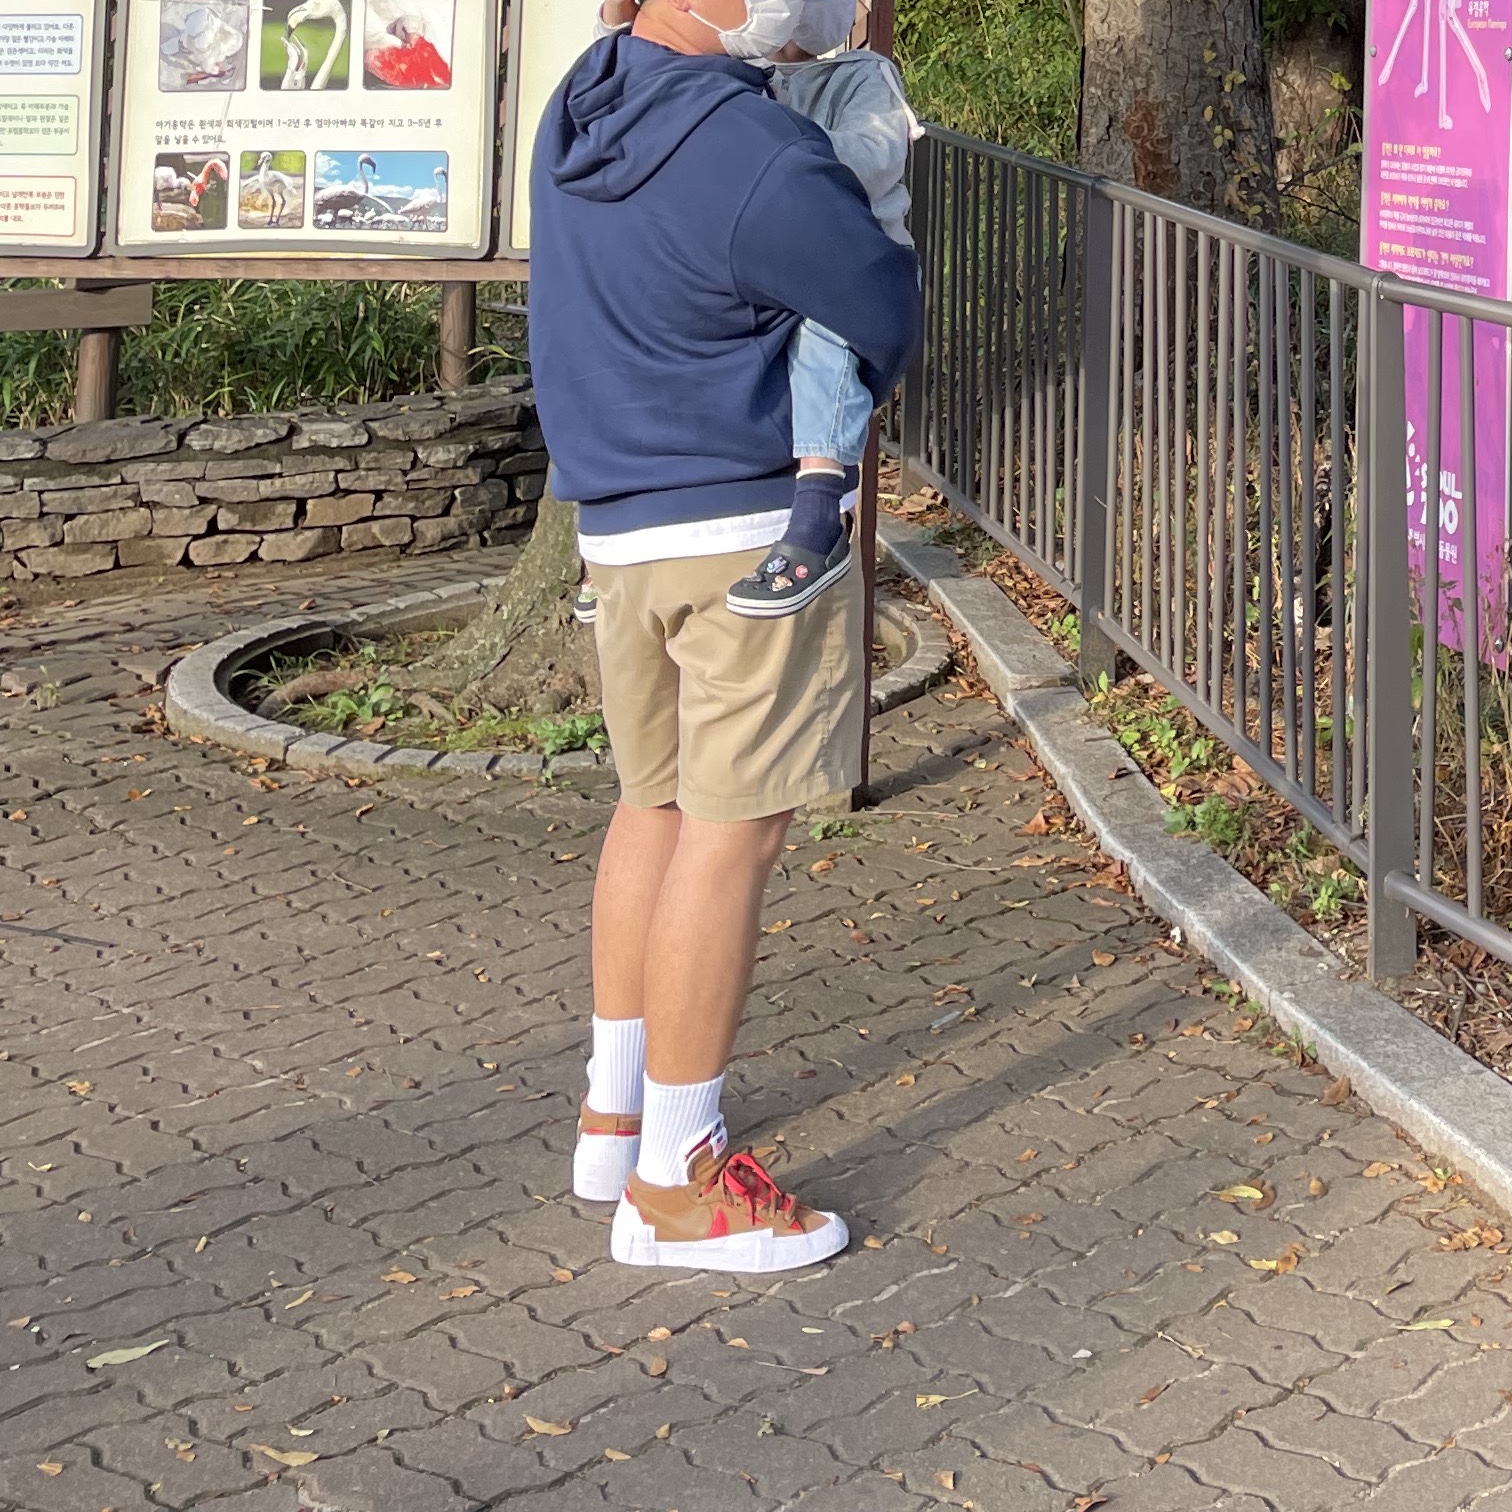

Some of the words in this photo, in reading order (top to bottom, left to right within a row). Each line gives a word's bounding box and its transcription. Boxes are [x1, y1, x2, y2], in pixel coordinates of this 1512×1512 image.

[155, 119, 195, 130] 아기홍학은
[303, 118, 312, 128] 후
[191, 135, 200, 144] 수
[1421, 462, 1462, 499] SUL
[1420, 491, 1458, 534] ZO
